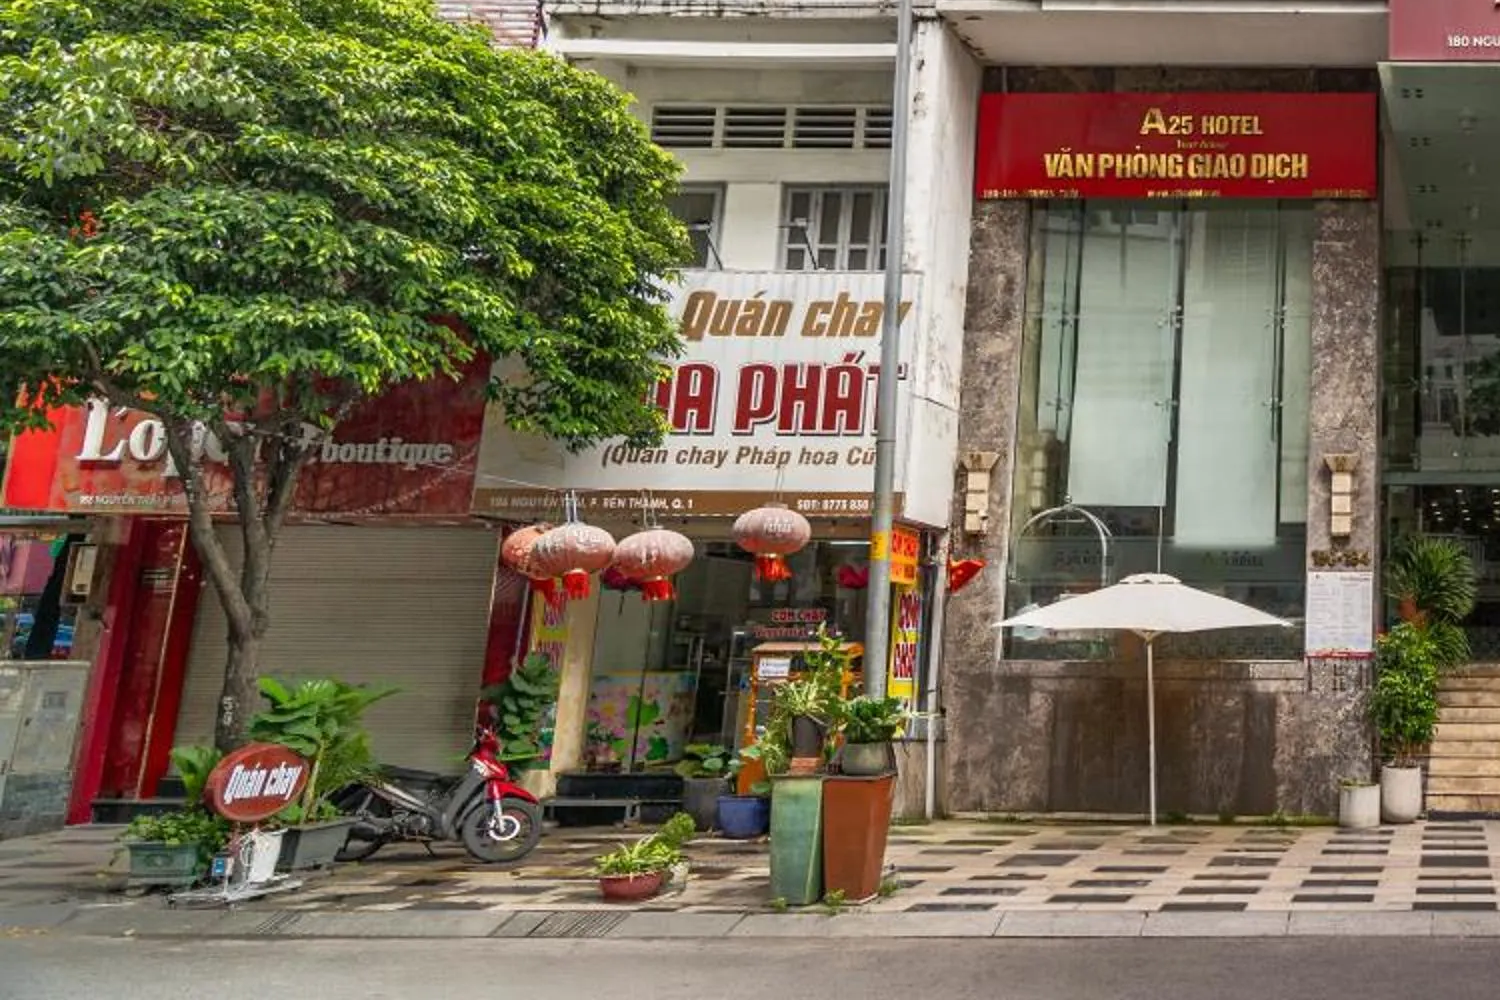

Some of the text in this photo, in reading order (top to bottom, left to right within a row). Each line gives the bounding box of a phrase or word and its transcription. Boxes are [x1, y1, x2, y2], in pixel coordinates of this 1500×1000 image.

[1447, 35, 1469, 47] 180
[1139, 107, 1263, 136] A25 HOTEL
[1044, 147, 1095, 179] VĂN
[1187, 152, 1246, 179] GIAO
[1251, 152, 1309, 184] DỊCH
[680, 290, 794, 342] Quán
[320, 436, 453, 471] boutique
[675, 446, 729, 469] chay
[735, 446, 792, 468] Pháp
[798, 447, 838, 465] hoa
